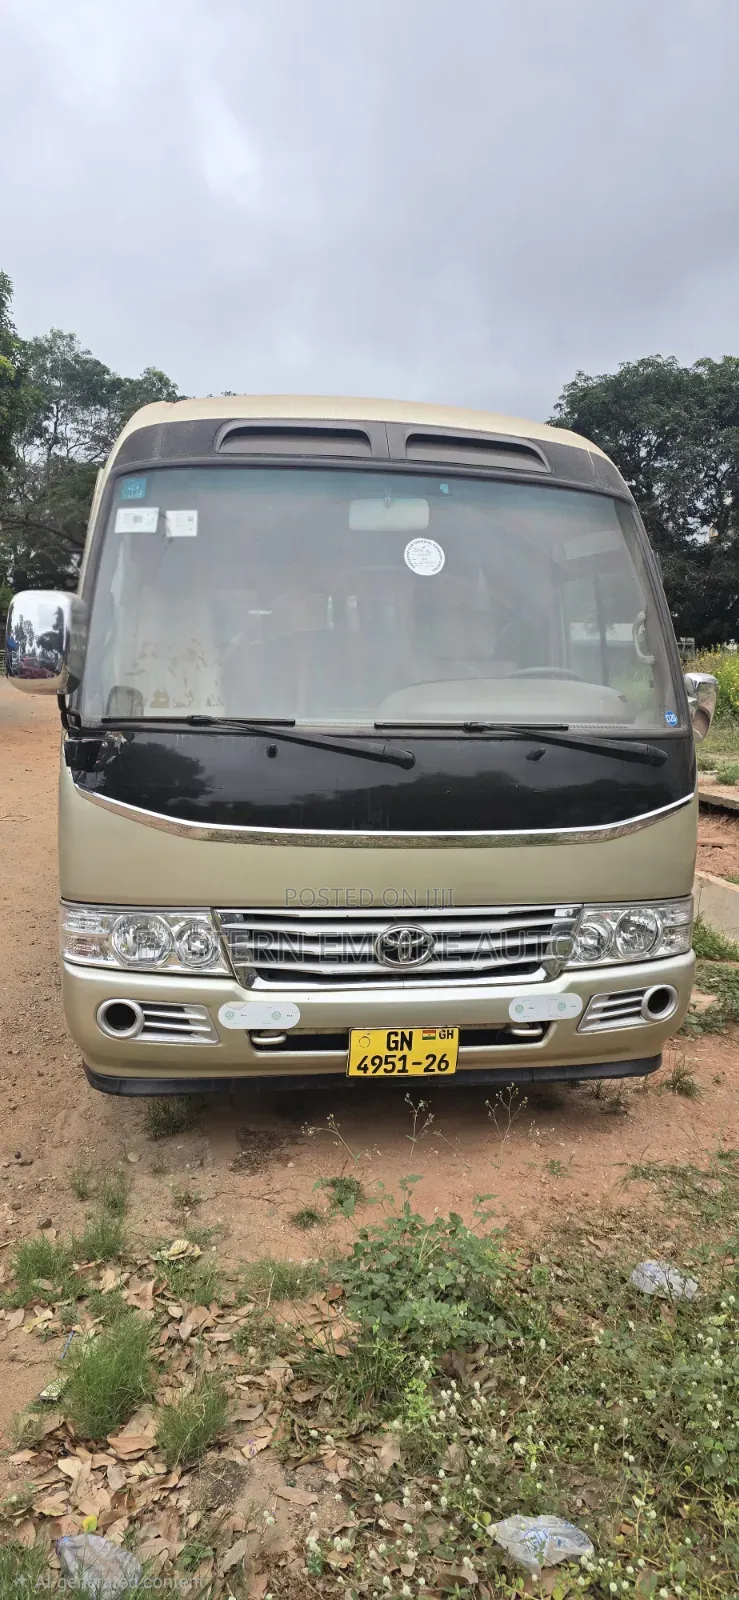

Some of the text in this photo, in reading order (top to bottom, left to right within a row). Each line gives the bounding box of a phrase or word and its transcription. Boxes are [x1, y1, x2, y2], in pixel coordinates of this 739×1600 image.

[386, 1030, 454, 1051] GN GH
[357, 1053, 450, 1074] 4951-26
